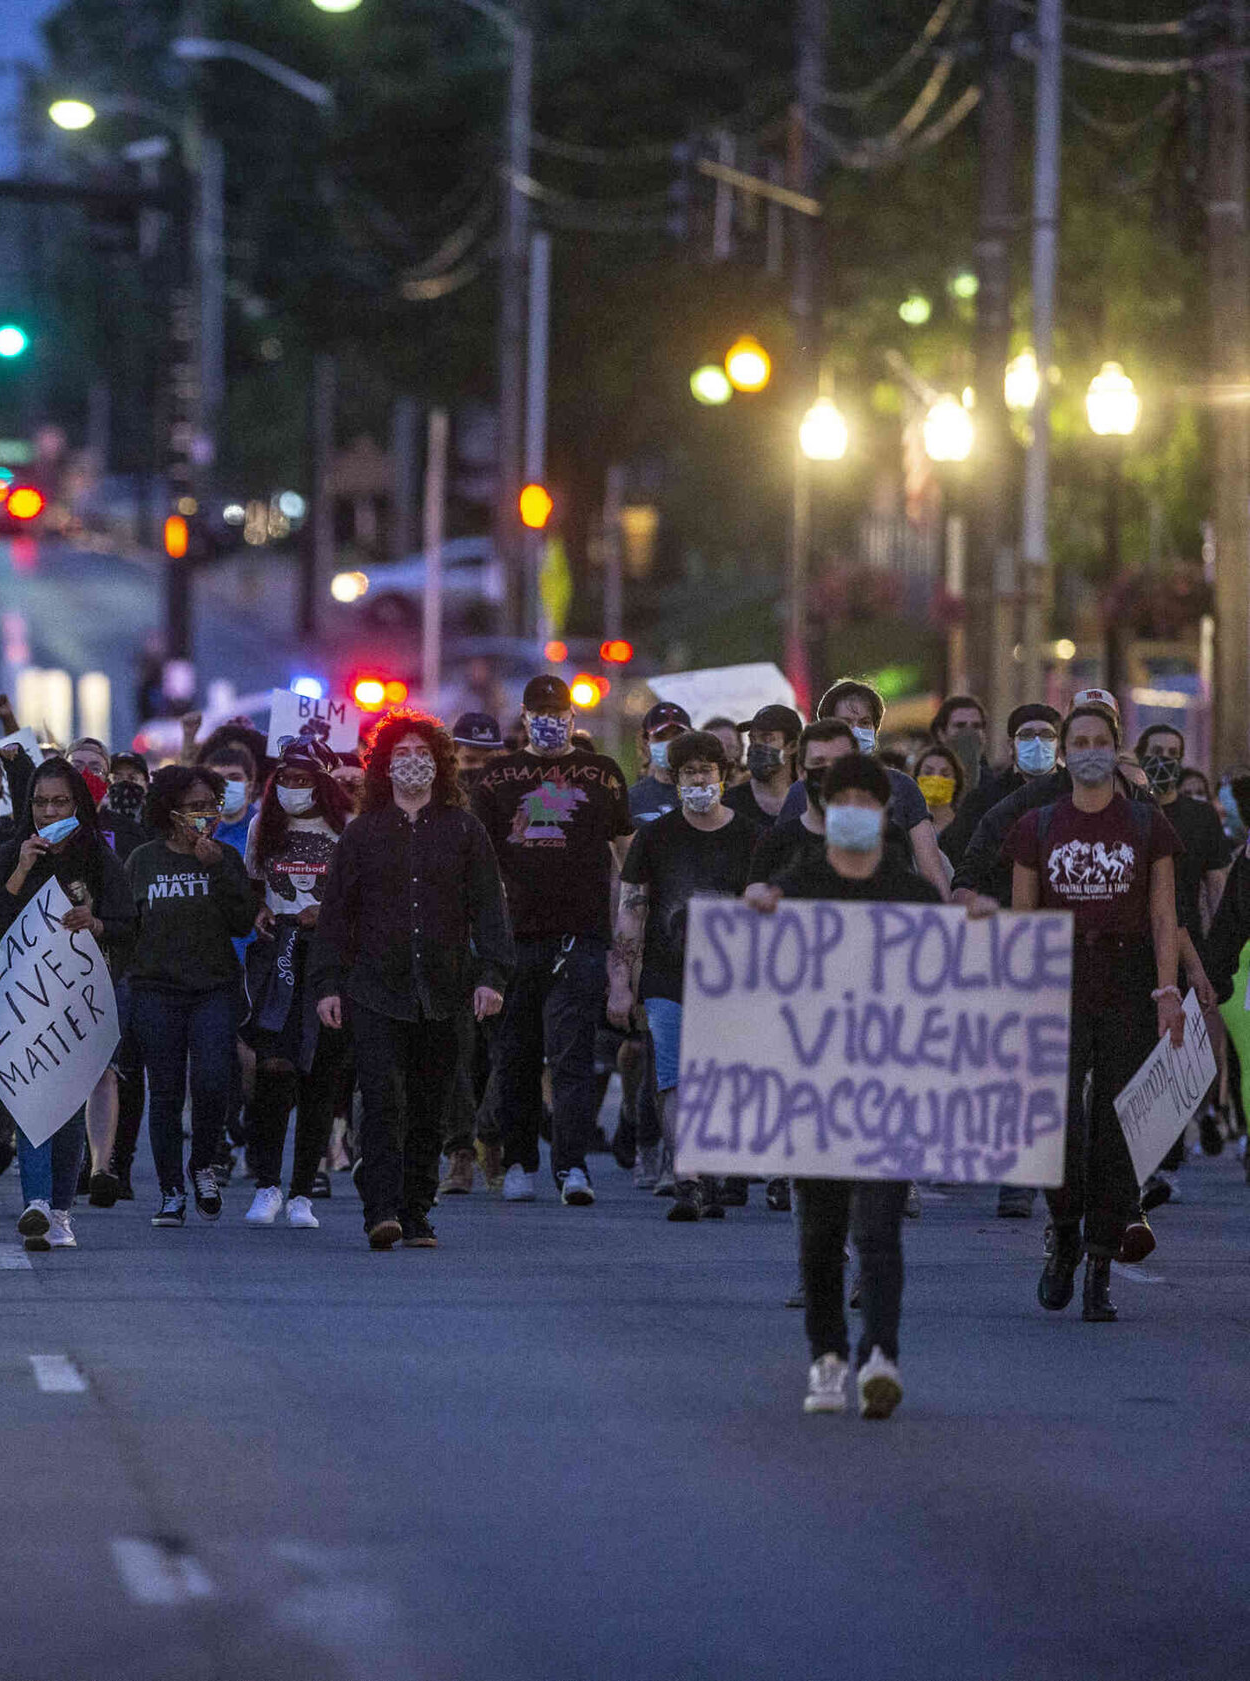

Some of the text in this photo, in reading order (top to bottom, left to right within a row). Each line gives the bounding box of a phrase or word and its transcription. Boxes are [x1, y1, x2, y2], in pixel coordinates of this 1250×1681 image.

[299, 695, 345, 724] BLM
[156, 872, 195, 882] BLACK
[692, 903, 1072, 998] STOP POLICE
